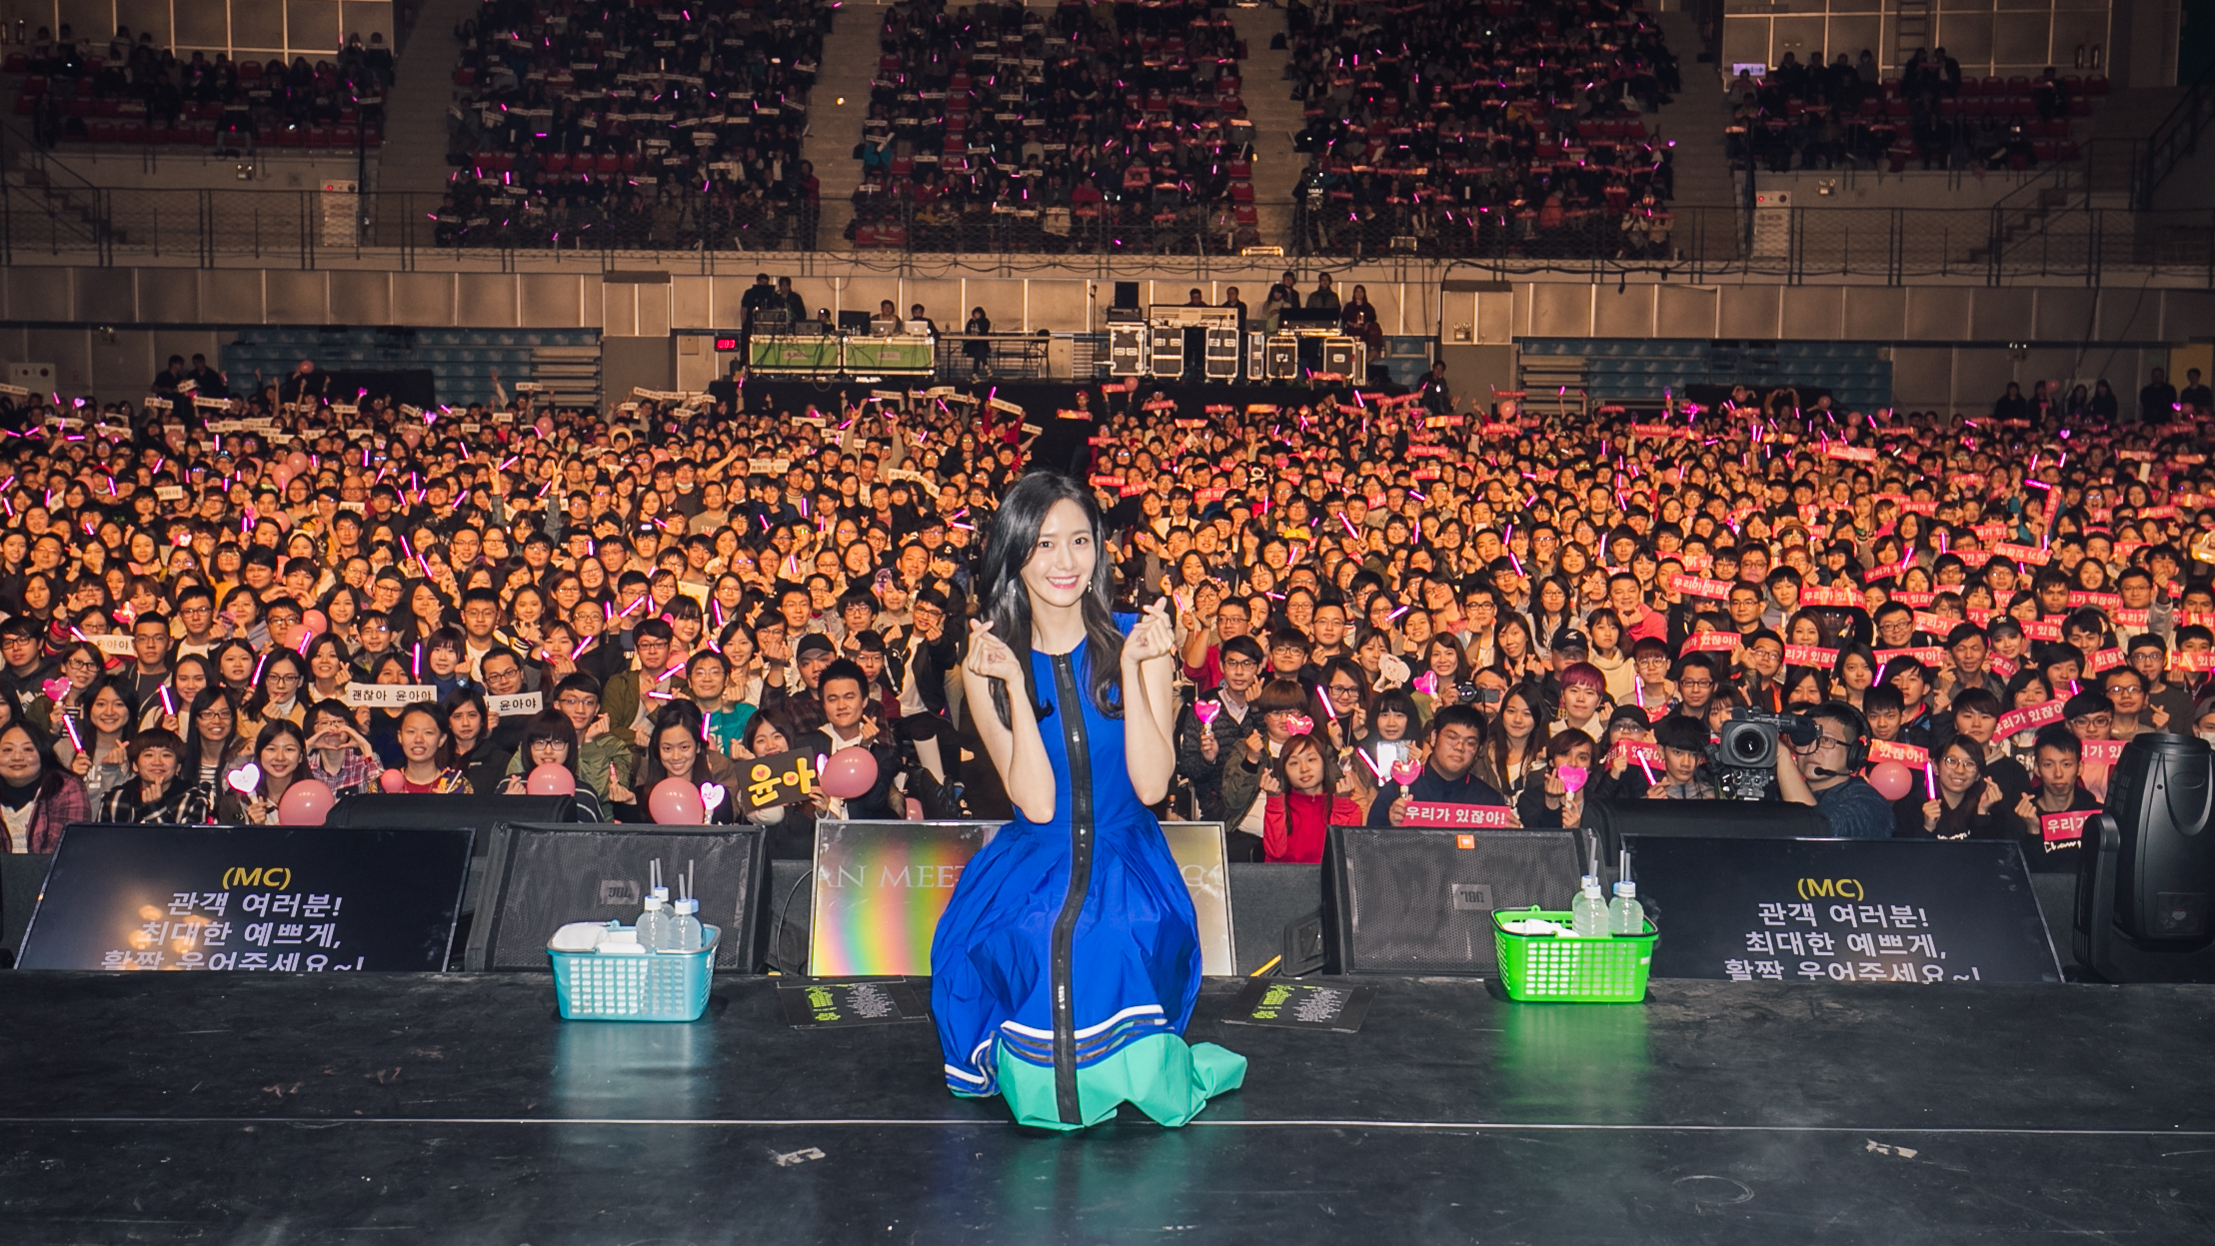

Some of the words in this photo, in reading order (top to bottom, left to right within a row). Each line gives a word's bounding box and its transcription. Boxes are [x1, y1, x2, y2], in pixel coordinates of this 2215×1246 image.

[1976, 527, 1992, 537] 리가
[1893, 559, 1916, 573] 있아!
[1803, 591, 1833, 602] 우리가
[1916, 616, 1947, 631] 우리가
[2117, 611, 2148, 622] 우리가
[1700, 634, 1736, 648] 있잖아!
[352, 689, 387, 701] 괜찮아
[395, 690, 432, 701] 윤아야
[499, 699, 536, 711] 윤아야
[1879, 744, 1923, 763] 있잖아!
[748, 757, 817, 807] 윤아
[1406, 806, 1451, 822] 우리가
[1455, 808, 1506, 826] 있잖아!
[222, 867, 292, 890] (MC)
[609, 886, 631, 898] JBL
[1460, 891, 1485, 903] JBL
[1797, 878, 1864, 901] (MC)
[167, 892, 230, 917] 관객
[242, 892, 342, 918] 여러분!
[1758, 902, 1818, 927] 관객
[1829, 904, 1929, 928] 여러분!
[136, 920, 233, 946] 최대한
[244, 922, 342, 949] 예쁘게,
[1745, 930, 1835, 956] 최대한
[1846, 932, 1947, 960] 예쁘게,
